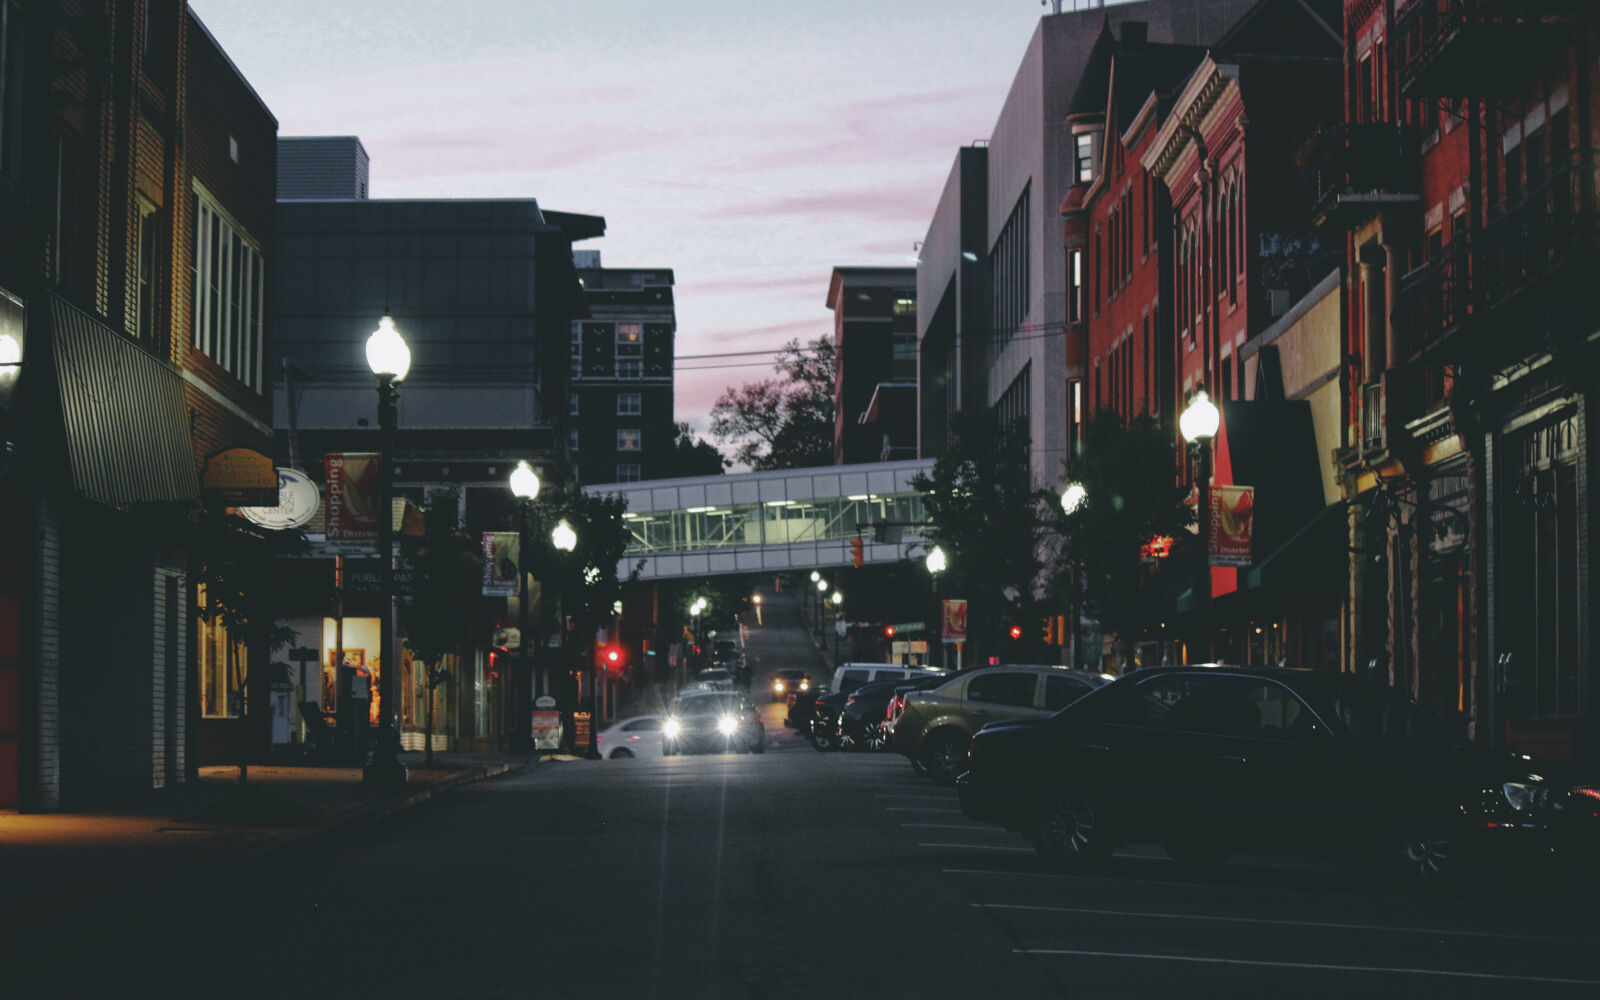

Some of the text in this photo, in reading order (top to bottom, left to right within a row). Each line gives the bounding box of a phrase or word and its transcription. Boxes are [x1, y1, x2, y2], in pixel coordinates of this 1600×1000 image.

[327, 456, 344, 537] Shopping
[1208, 489, 1223, 553] Shopping
[352, 572, 384, 584] PUBLI
